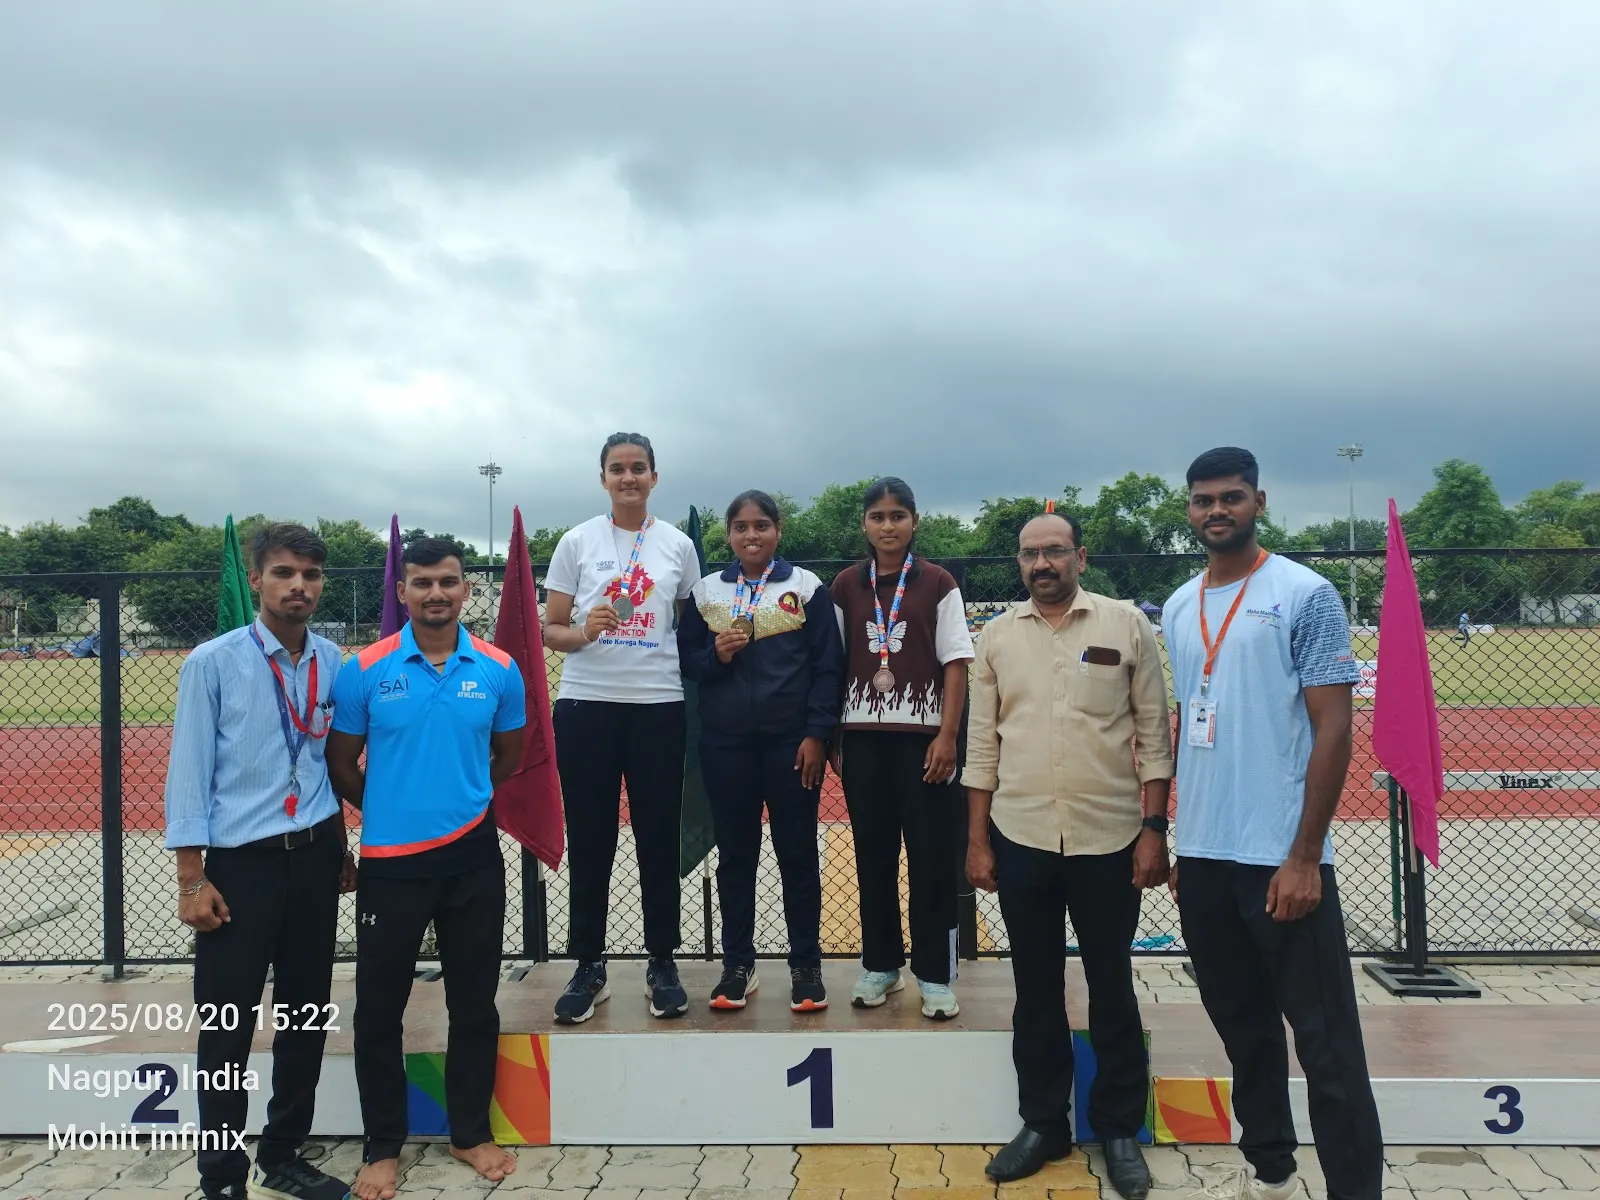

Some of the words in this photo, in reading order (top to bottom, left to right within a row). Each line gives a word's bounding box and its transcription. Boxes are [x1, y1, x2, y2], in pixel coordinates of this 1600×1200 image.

[605, 629, 647, 637] DISTINCTION
[614, 639, 637, 647] Karega
[638, 640, 660, 649] Nagpur
[378, 678, 409, 694] SAI
[457, 691, 487, 700] ATHLETICS
[1499, 775, 1553, 789] Vinex
[131, 1062, 179, 1124] 2
[786, 1047, 834, 1129] 1
[1483, 1085, 1524, 1135] 3
